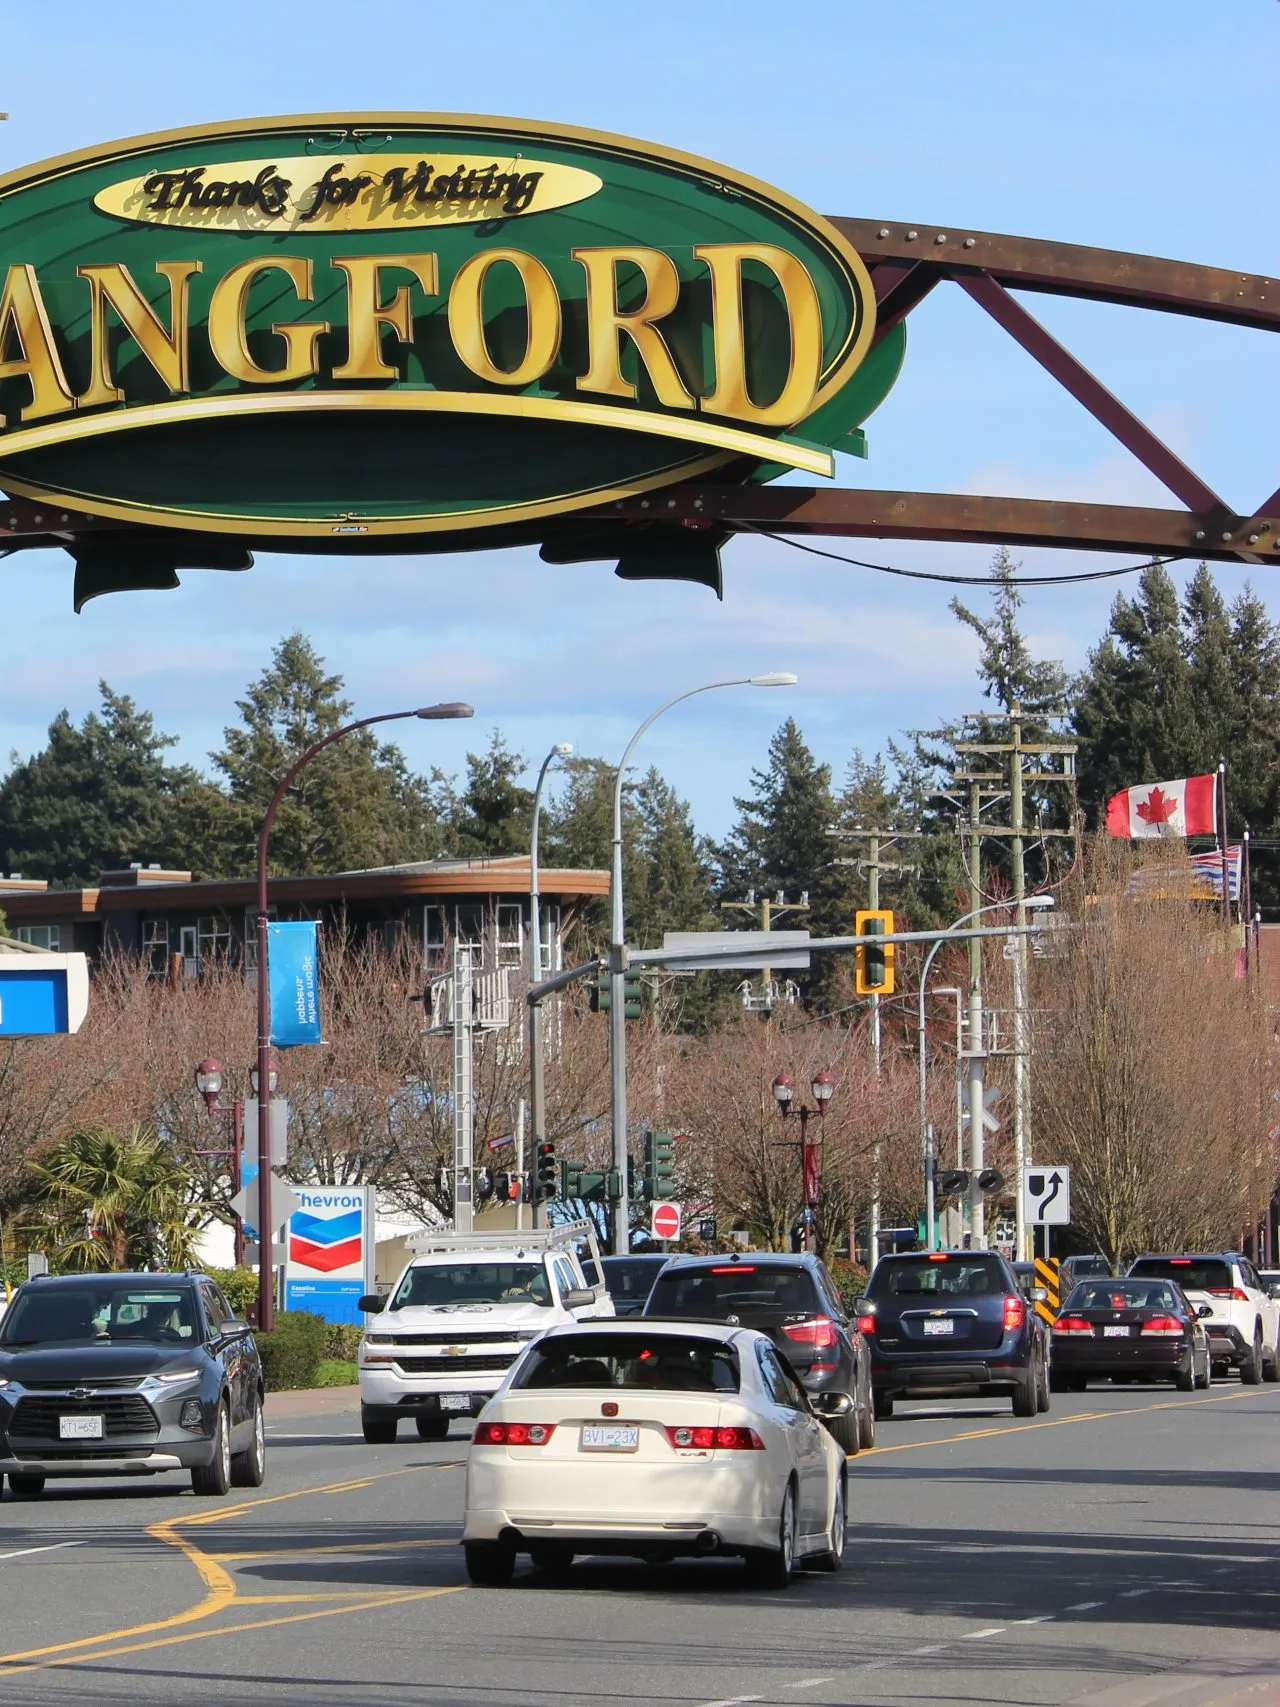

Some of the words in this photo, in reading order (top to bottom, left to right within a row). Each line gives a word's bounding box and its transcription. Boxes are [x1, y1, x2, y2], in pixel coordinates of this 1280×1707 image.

[145, 164, 291, 219] Thanks
[300, 162, 372, 220] for
[382, 160, 544, 214] Visiting
[293, 1192, 362, 1207] hevron
